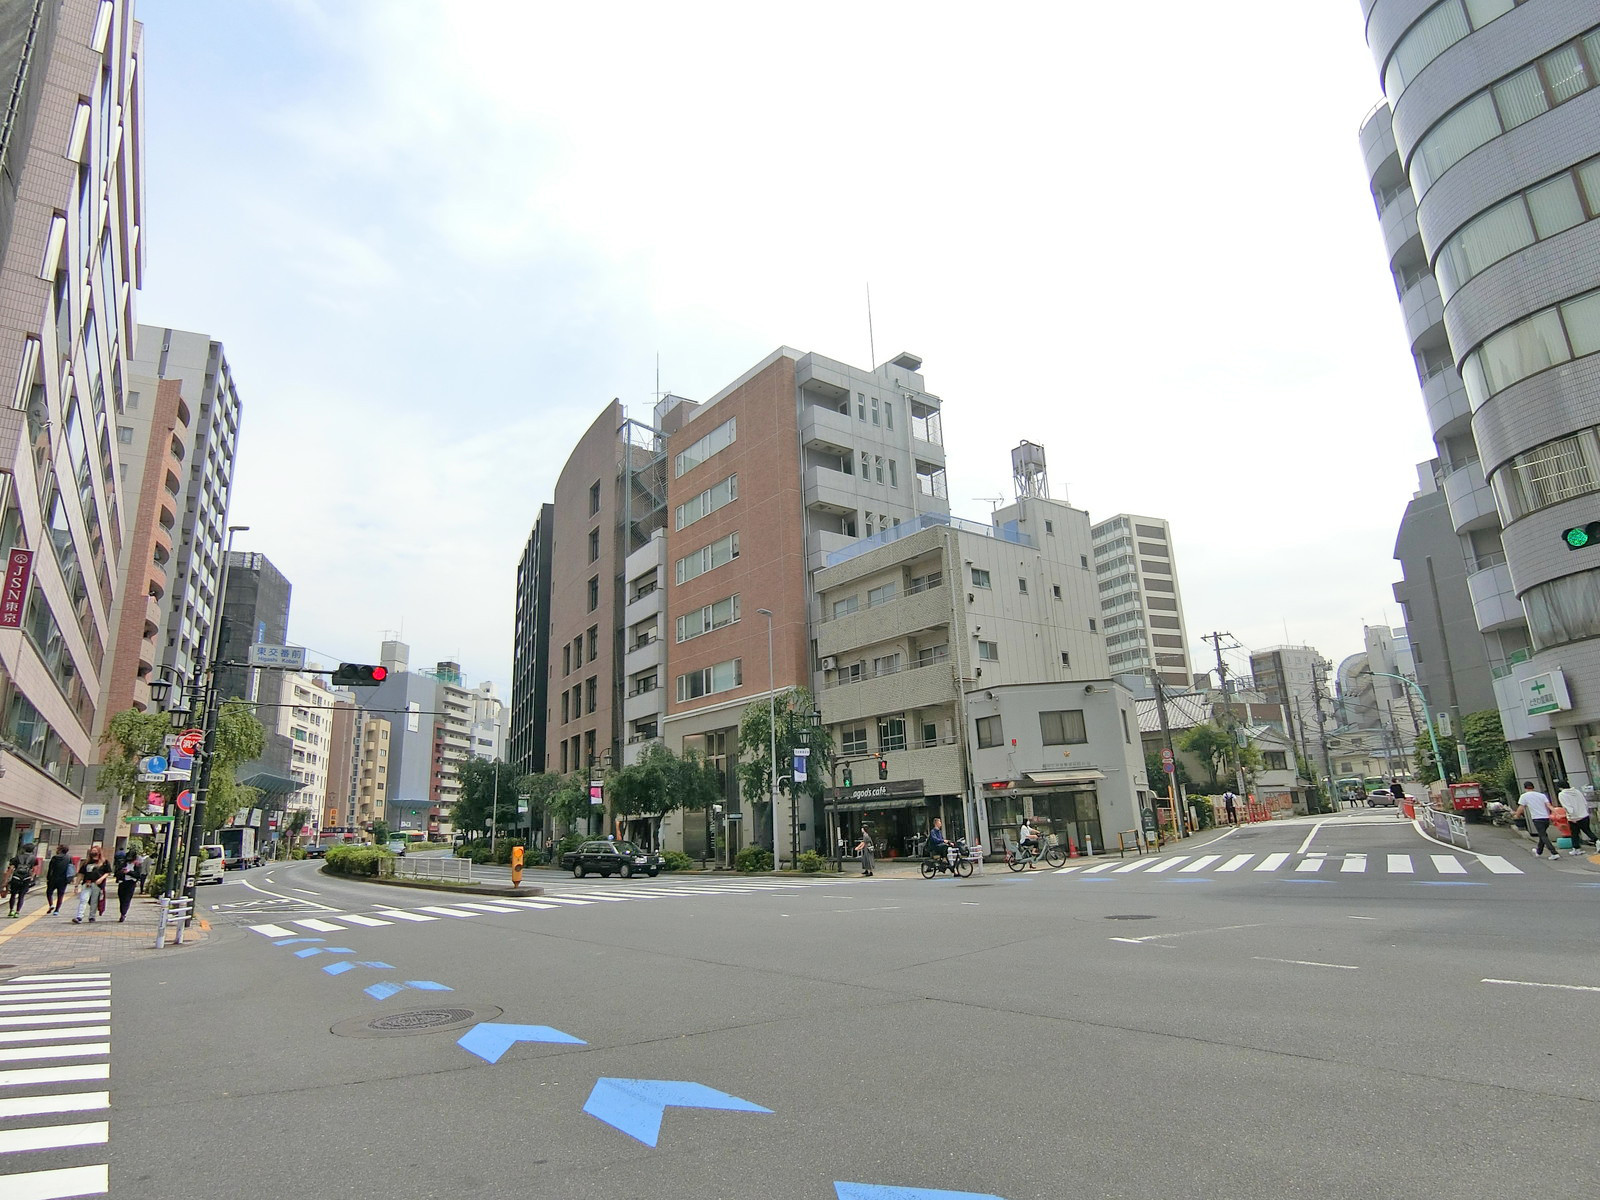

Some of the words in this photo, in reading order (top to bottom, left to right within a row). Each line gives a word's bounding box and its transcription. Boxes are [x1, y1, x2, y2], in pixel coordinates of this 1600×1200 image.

[3, 565, 24, 623] JSN東京
[257, 647, 301, 658] 東交番前
